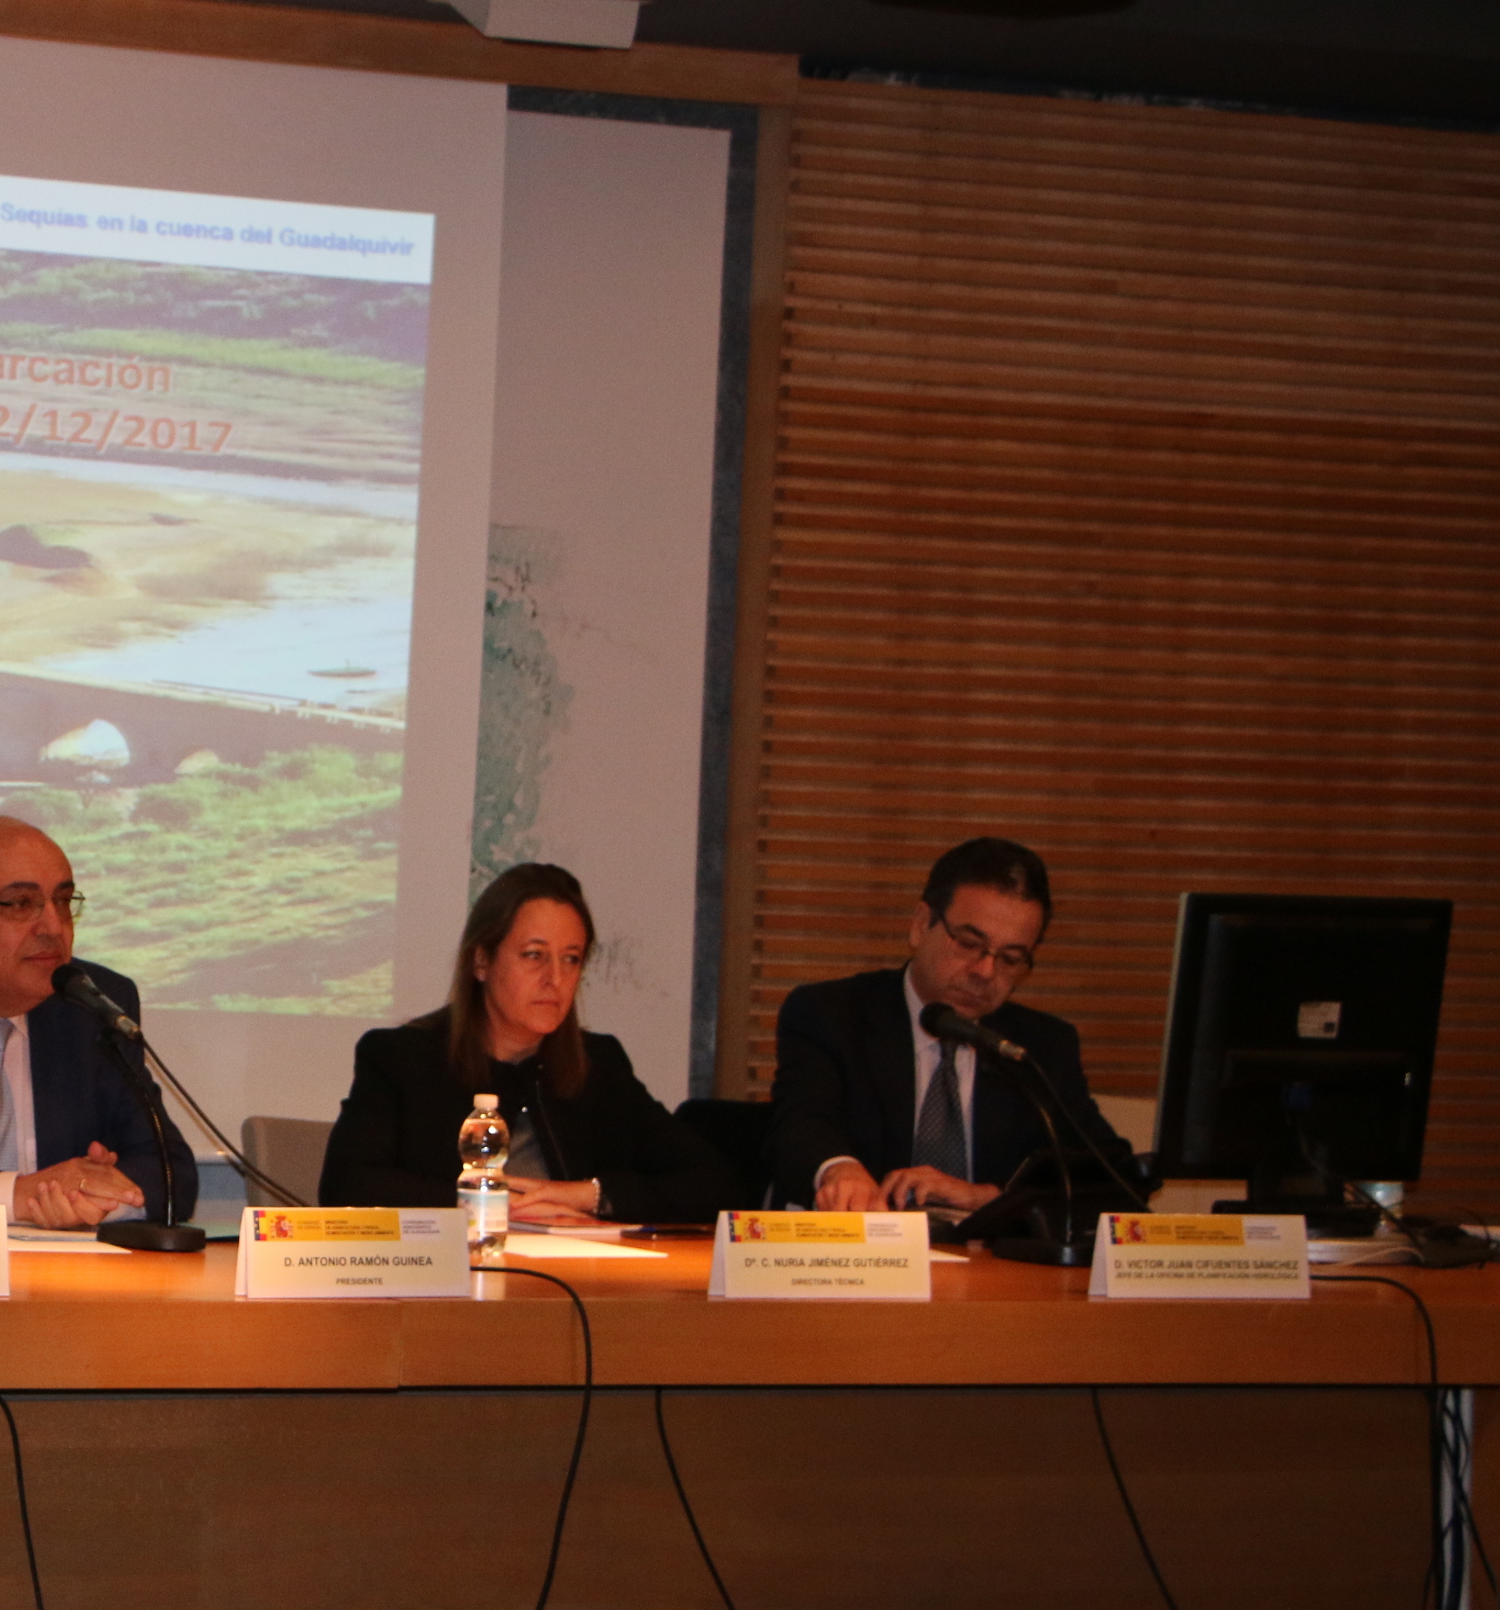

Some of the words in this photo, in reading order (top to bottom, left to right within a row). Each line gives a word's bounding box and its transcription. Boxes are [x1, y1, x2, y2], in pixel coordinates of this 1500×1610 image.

[96, 214, 123, 232] en
[130, 214, 148, 233] la
[155, 220, 234, 242] cuenca
[240, 225, 272, 245] del
[279, 227, 414, 256] Guadalquivir
[297, 1256, 347, 1266] ANTONIO
[349, 1254, 390, 1266] RAMÓN
[392, 1256, 433, 1266] GUINEA
[774, 1258, 805, 1268] NURIA
[808, 1256, 850, 1268] JIMÉNEZ
[335, 1277, 383, 1285] PRESIDENTE
